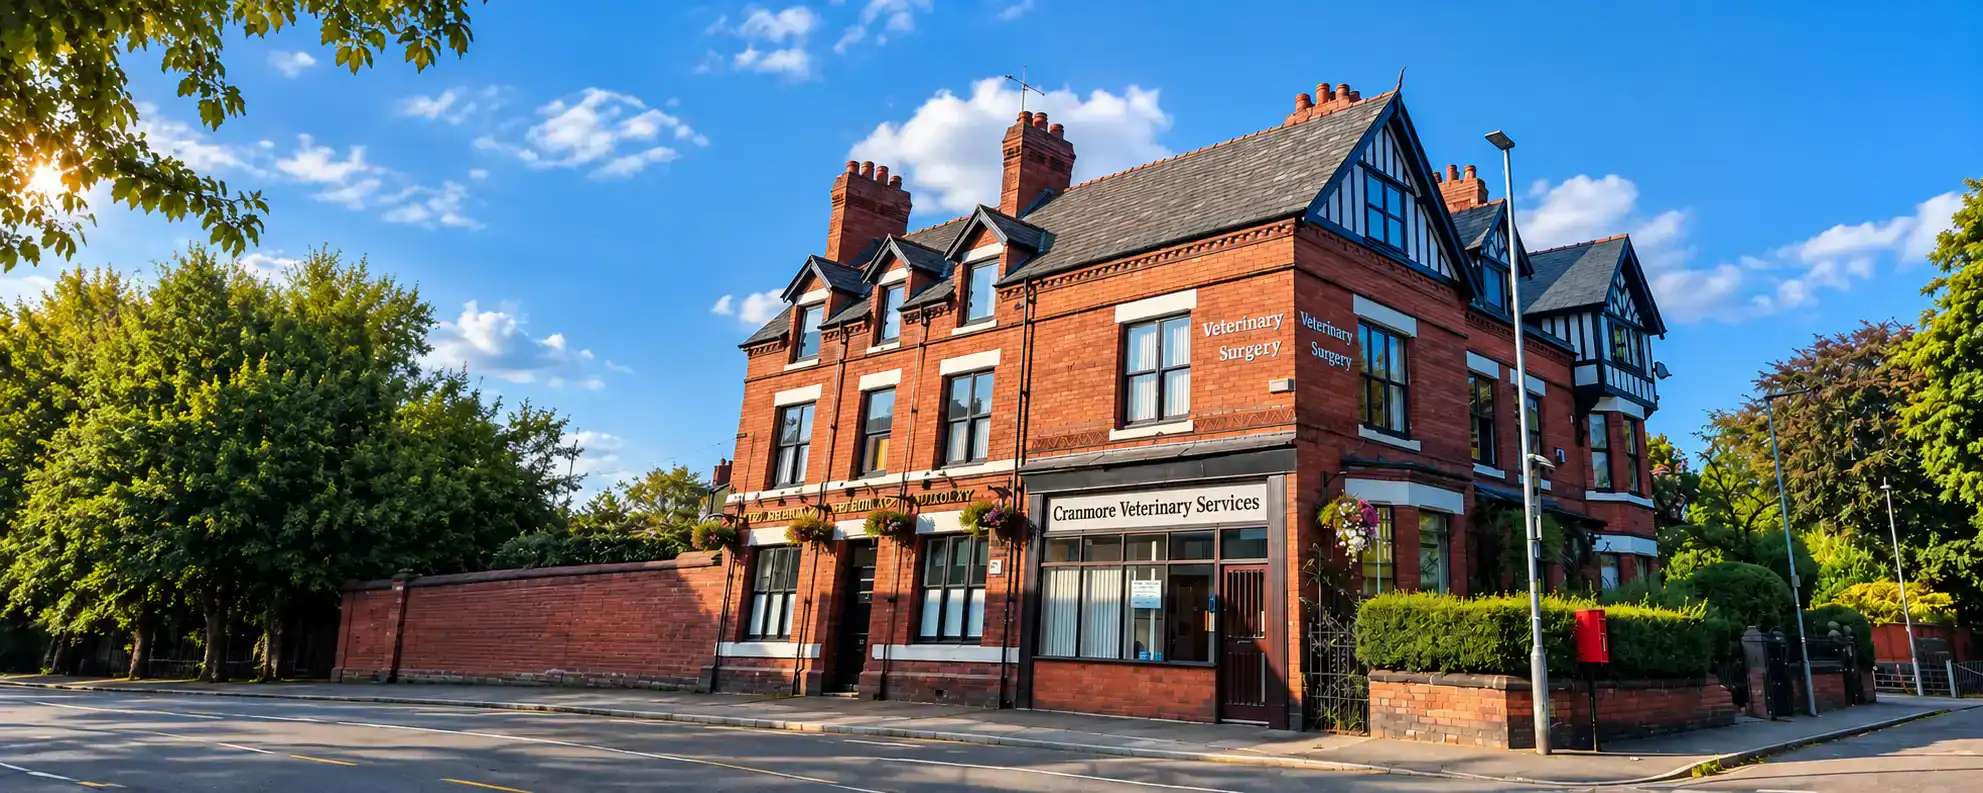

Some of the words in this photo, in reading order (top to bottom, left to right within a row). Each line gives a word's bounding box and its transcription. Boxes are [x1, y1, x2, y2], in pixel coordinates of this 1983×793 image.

[1202, 313, 1284, 337] Veterinary
[1300, 311, 1353, 346] Veterinary
[1219, 340, 1282, 362] Surgery
[1311, 341, 1352, 371] Surgery
[1053, 505, 1116, 521] Cranmore
[1120, 498, 1192, 518] Veterinary
[1196, 494, 1260, 513] Services
